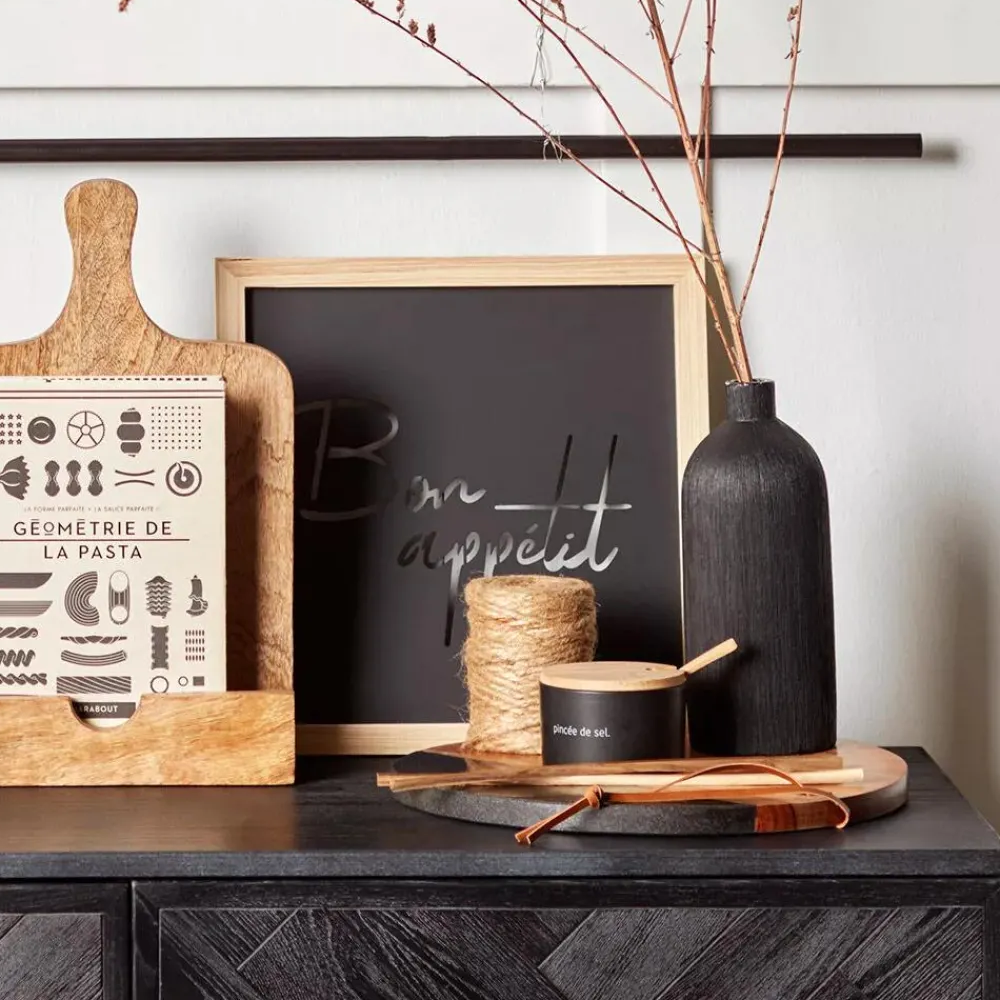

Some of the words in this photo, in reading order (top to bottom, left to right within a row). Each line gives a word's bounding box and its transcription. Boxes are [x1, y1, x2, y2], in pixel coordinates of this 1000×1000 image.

[294, 397, 486, 521] Bon
[146, 521, 172, 535] DE
[397, 434, 632, 646] appétit
[44, 545, 69, 559] LA
[79, 545, 142, 559] PASTA
[580, 726, 591, 737] de
